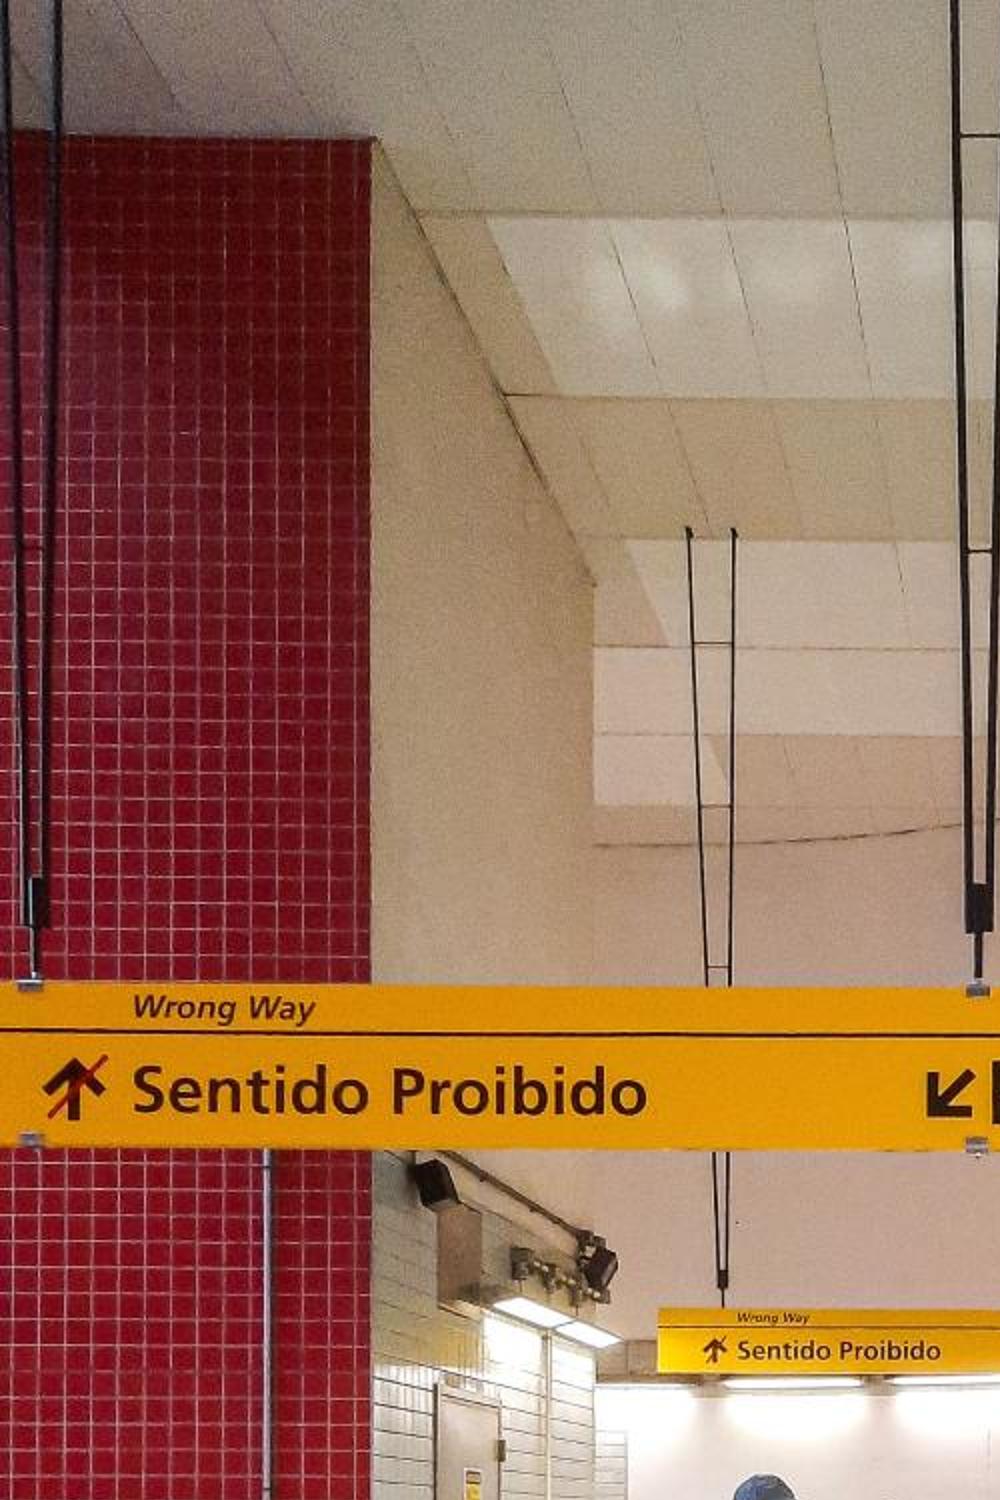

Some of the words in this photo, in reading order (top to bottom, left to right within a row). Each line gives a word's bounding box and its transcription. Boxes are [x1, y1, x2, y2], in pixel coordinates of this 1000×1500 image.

[132, 994, 237, 1027] Wrong
[248, 995, 317, 1026] Way
[133, 1063, 370, 1115] Sentido
[392, 1065, 648, 1117] Proibido
[736, 1311, 779, 1325] Wrong
[782, 1311, 810, 1325] Way
[737, 1339, 831, 1361] Sentido
[839, 1340, 941, 1361] Proibido
